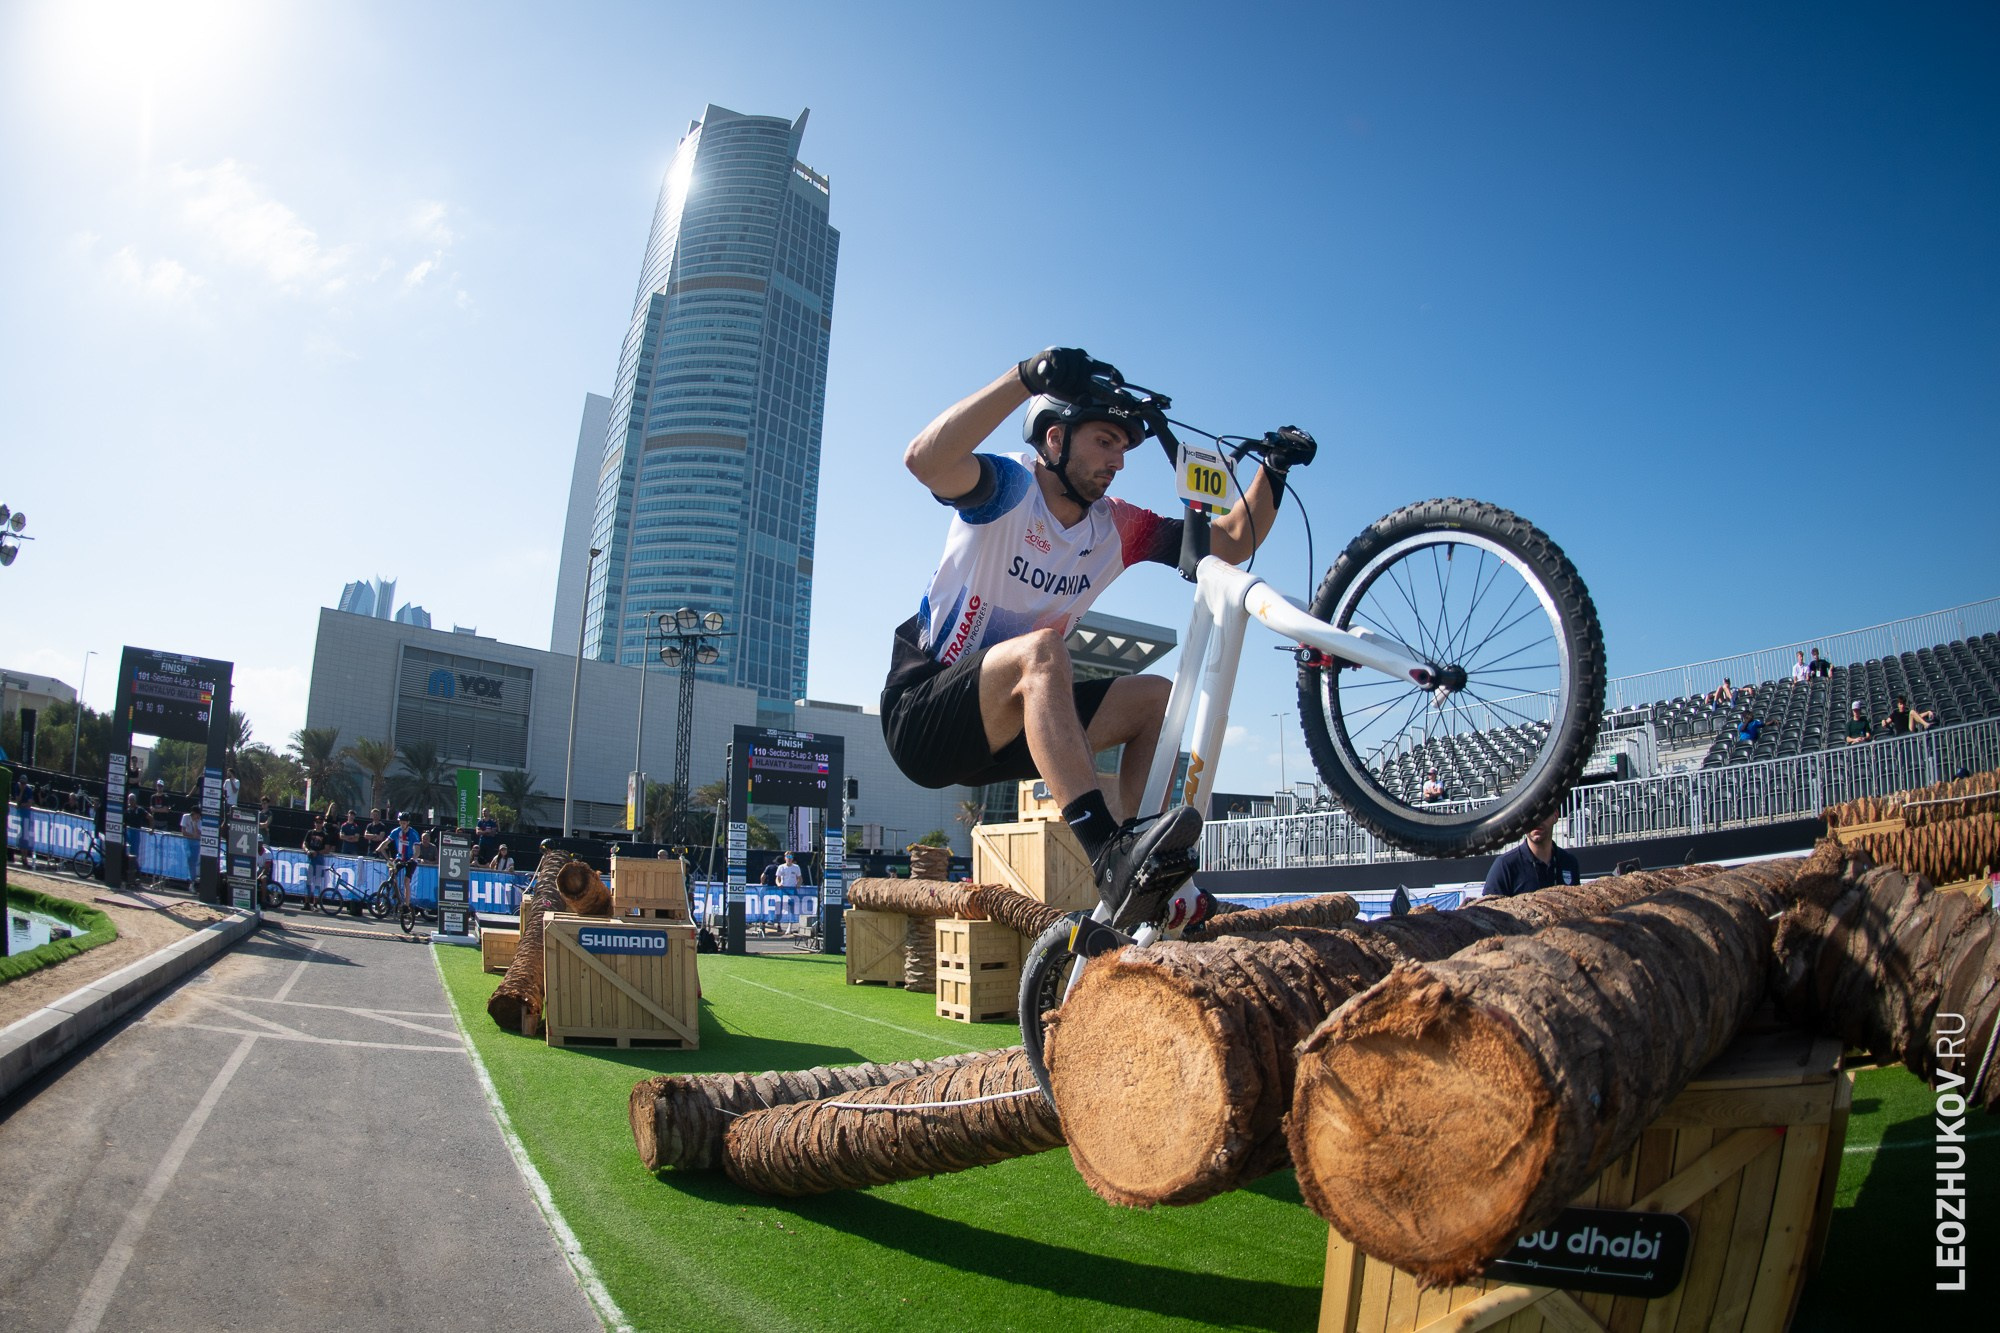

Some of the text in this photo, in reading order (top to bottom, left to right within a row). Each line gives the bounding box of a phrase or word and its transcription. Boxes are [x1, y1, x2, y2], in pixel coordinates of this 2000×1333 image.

[1194, 467, 1222, 495] 110
[1008, 555, 1091, 596] SLOVAKIA
[970, 601, 988, 641] PROGRESS
[940, 594, 981, 667] STRABAG
[161, 662, 188, 674] FINISH
[138, 671, 150, 681] 101
[460, 674, 504, 699] VOX
[197, 711, 209, 722] 30
[777, 739, 804, 749] FINISH
[754, 747, 767, 756] 110
[814, 753, 829, 762] 1:32
[755, 758, 813, 770] HLAVATY Samuel
[754, 774, 827, 789] 10 10
[7, 814, 96, 853] SHIMA
[230, 823, 257, 834] FINISH
[236, 834, 250, 854] 4
[442, 848, 468, 858] START
[448, 858, 461, 878] 5
[842, 872, 862, 880] INISH
[693, 892, 819, 916] SHMANO
[581, 934, 666, 949] SHIMANO
[1518, 1226, 1662, 1260] bu dhabi
